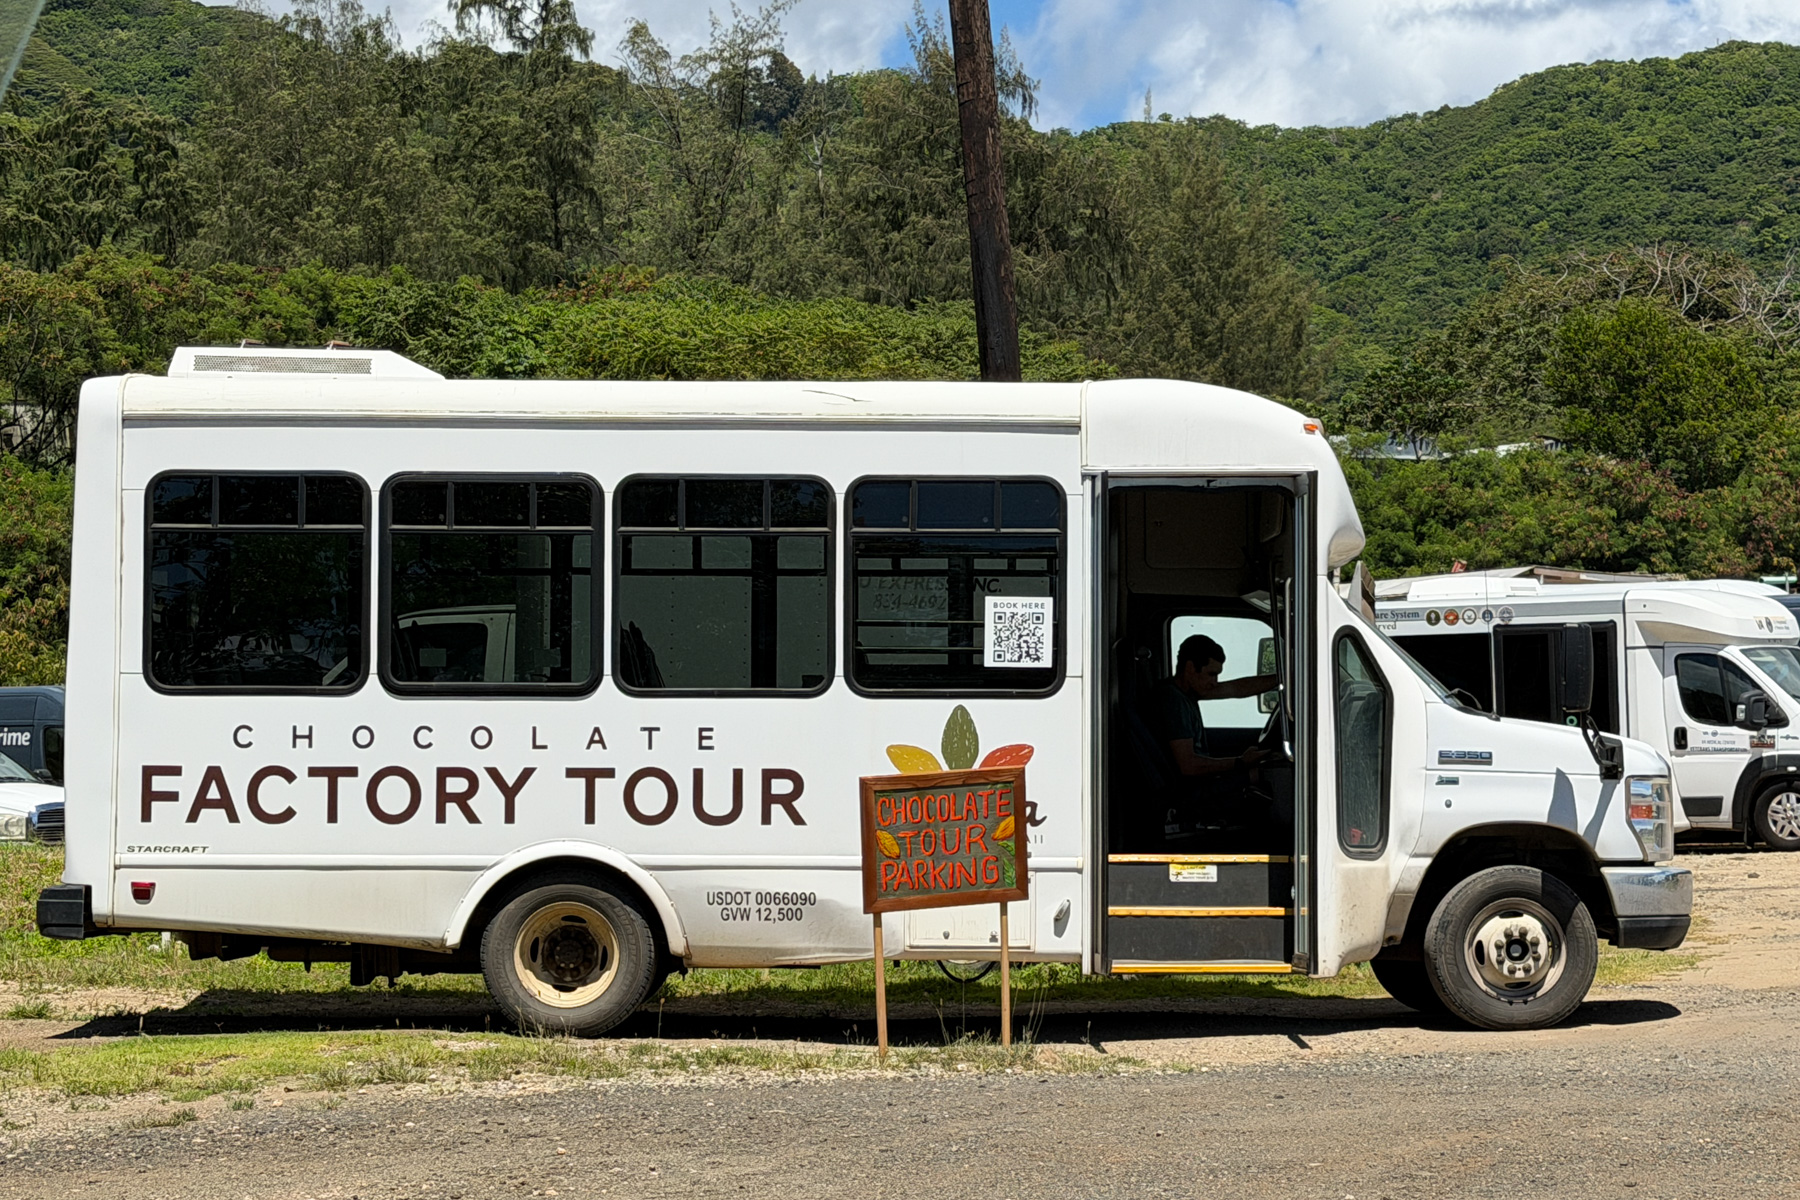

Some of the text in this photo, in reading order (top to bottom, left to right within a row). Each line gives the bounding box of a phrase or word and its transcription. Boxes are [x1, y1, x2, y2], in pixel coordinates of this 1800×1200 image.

[878, 576, 948, 591] EXPRES
[972, 577, 1002, 593] NC.
[1390, 611, 1420, 621] System
[0, 727, 31, 746] rime
[232, 724, 715, 752] CHOCOLATE
[140, 764, 808, 827] FACTORY TOUR
[877, 788, 1011, 827] CHOCOLATE
[126, 845, 210, 853] STARCRAFT
[897, 823, 989, 858] TOUR
[880, 854, 999, 892] PARKING
[706, 891, 817, 907] USDOT 0066090
[720, 907, 804, 924] GVW 12,500
